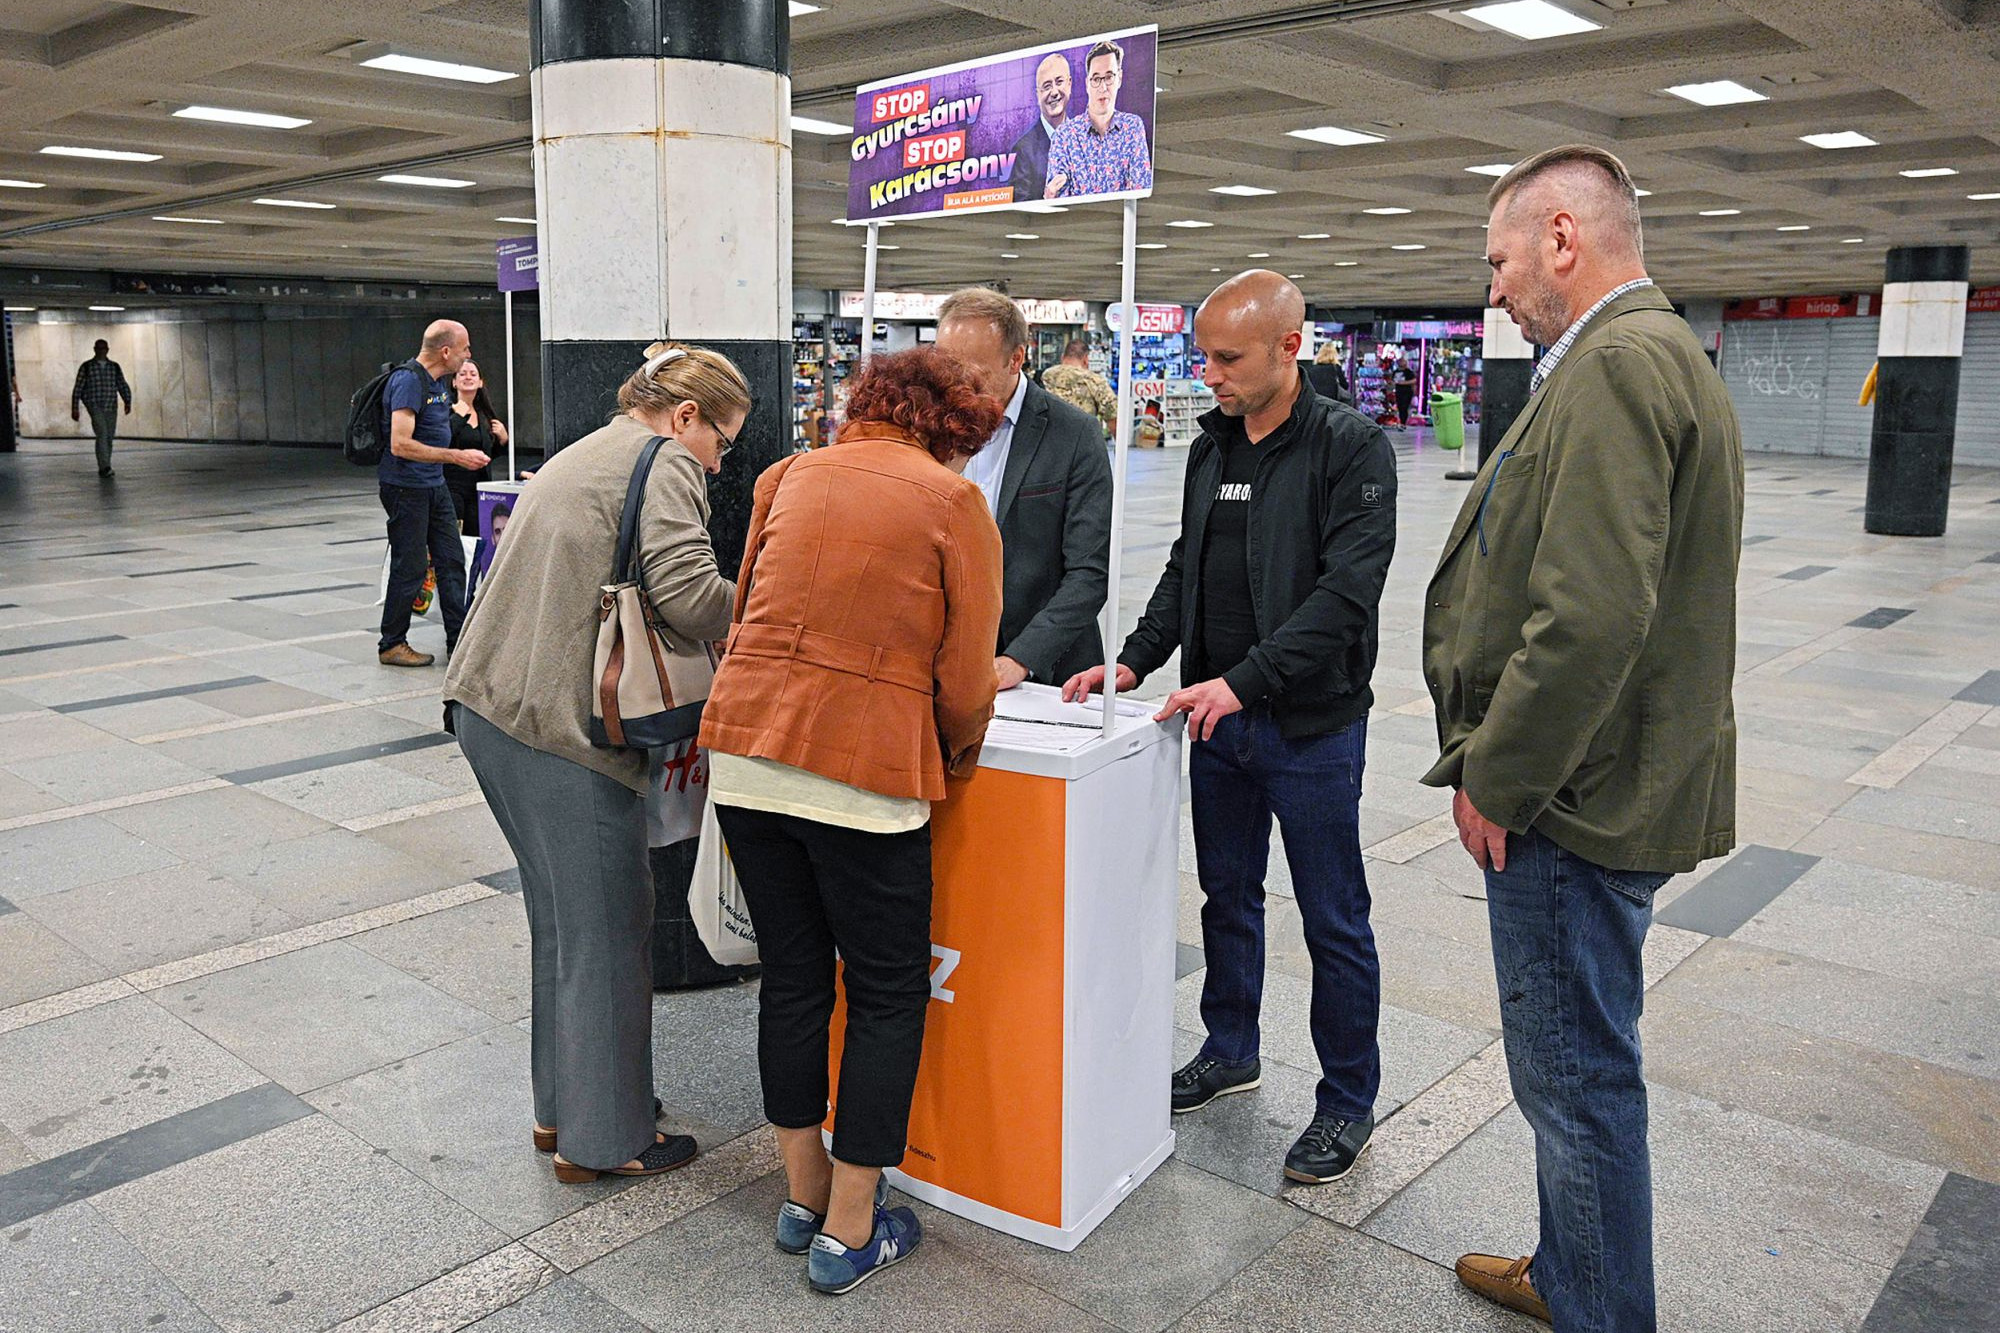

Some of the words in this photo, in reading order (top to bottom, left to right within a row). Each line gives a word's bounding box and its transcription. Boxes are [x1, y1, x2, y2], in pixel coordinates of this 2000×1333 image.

[875, 90, 925, 118] STOP
[851, 95, 982, 161] Gyurcsány
[907, 136, 961, 164] STOP
[869, 152, 1017, 209] Karácsony
[1140, 311, 1174, 332] GSM
[1134, 381, 1165, 398] GSM
[1214, 483, 1252, 501] YARO
[1364, 486, 1379, 502] ck
